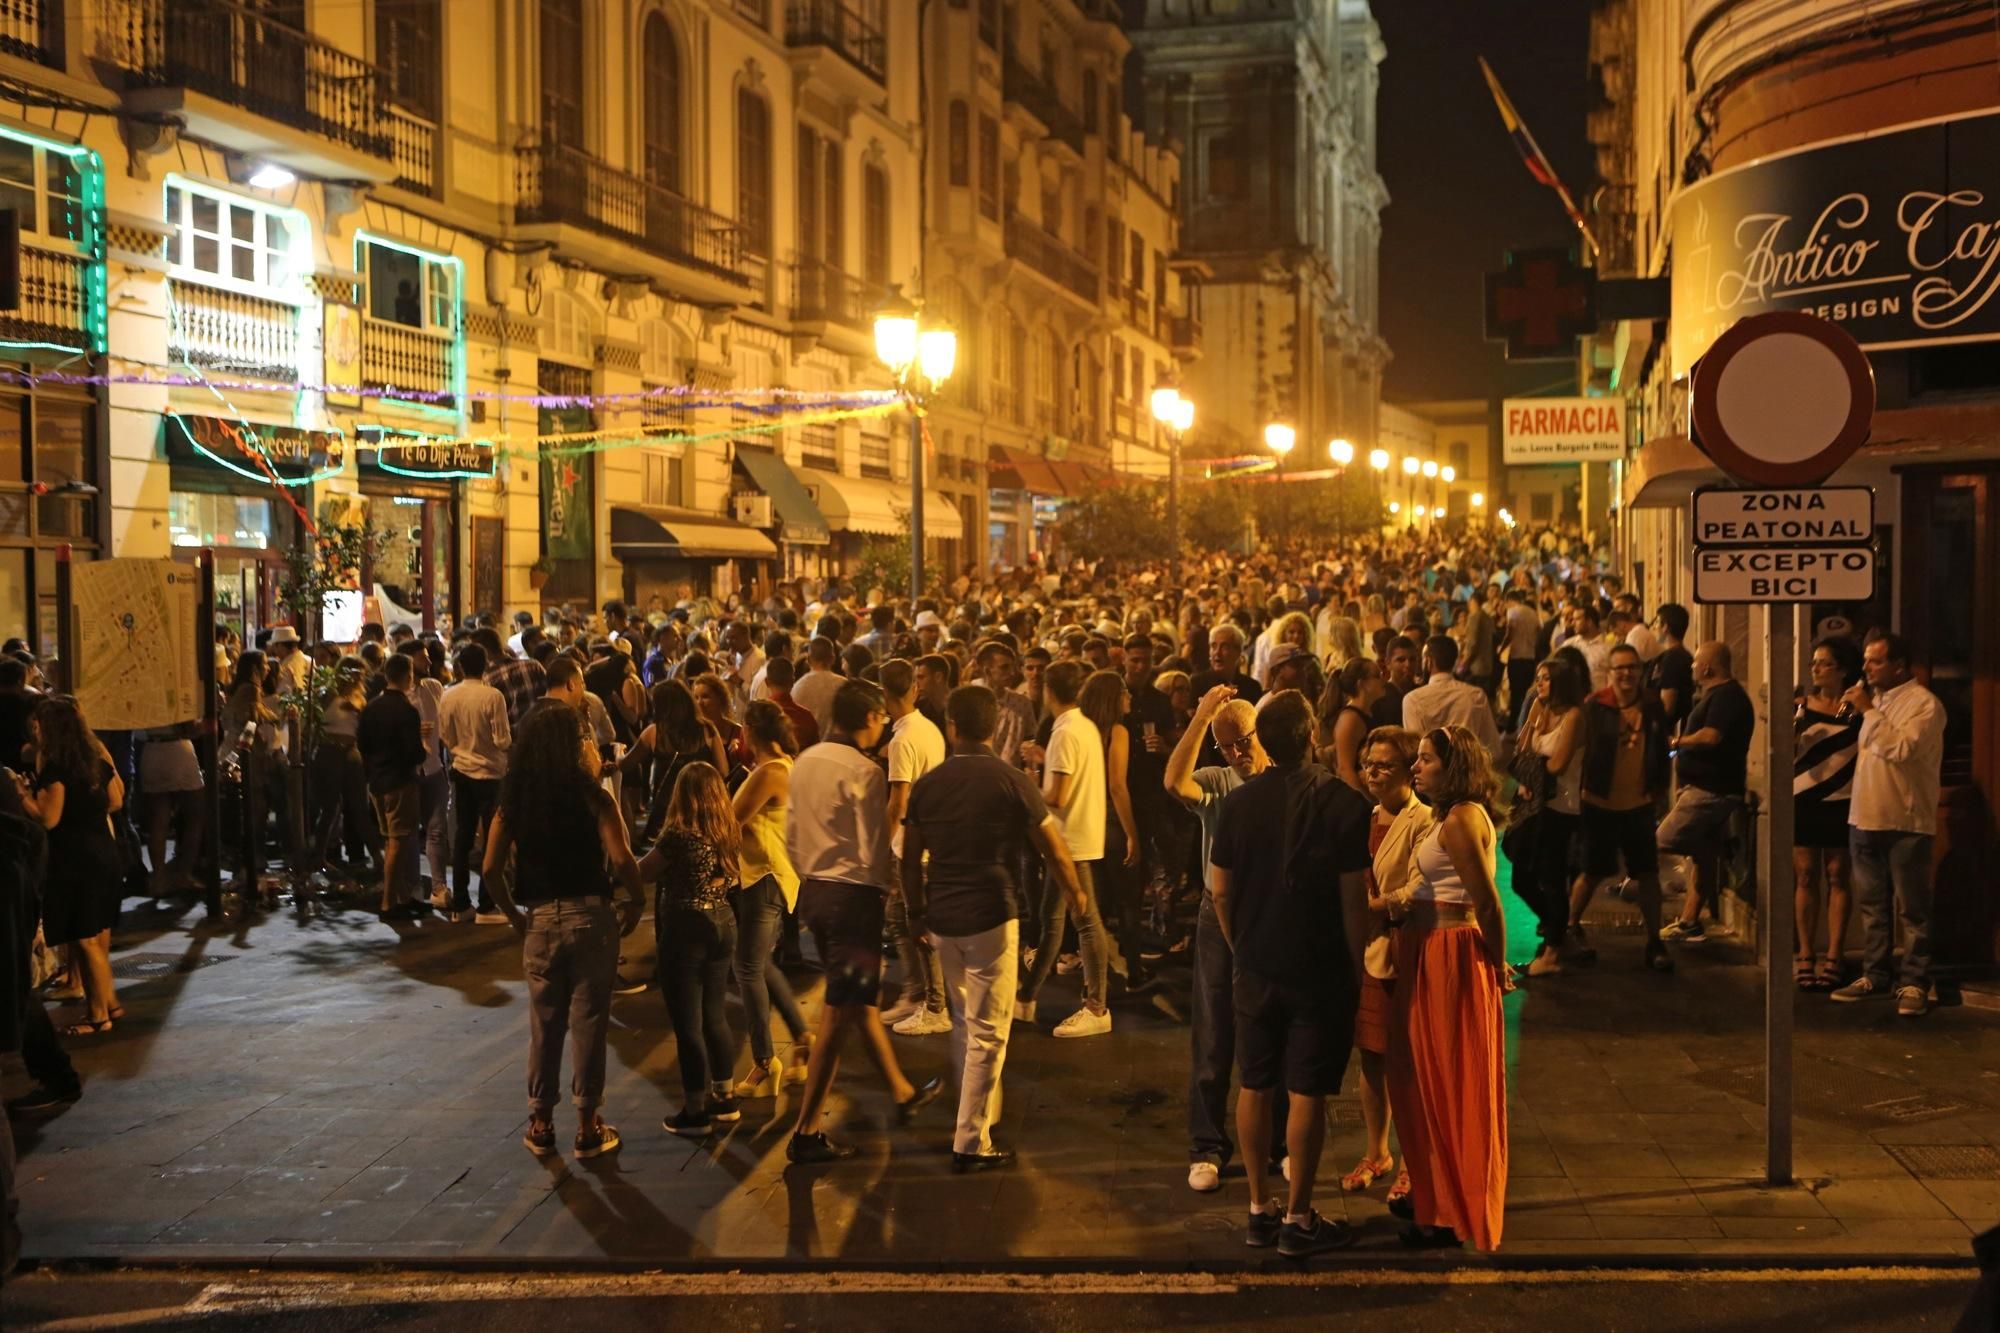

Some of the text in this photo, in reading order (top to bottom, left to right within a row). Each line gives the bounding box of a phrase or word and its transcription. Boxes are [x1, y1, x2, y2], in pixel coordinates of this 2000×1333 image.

[1716, 192, 1880, 311] Antico
[1509, 406, 1619, 435] FARMACIA
[430, 443, 450, 469] Dije
[453, 445, 481, 469] Pérez
[1742, 493, 1826, 511] ZONA
[1704, 520, 1863, 539] PEATONAL
[1702, 552, 1867, 572] EXCEPTO
[1751, 578, 1817, 596] BICI
